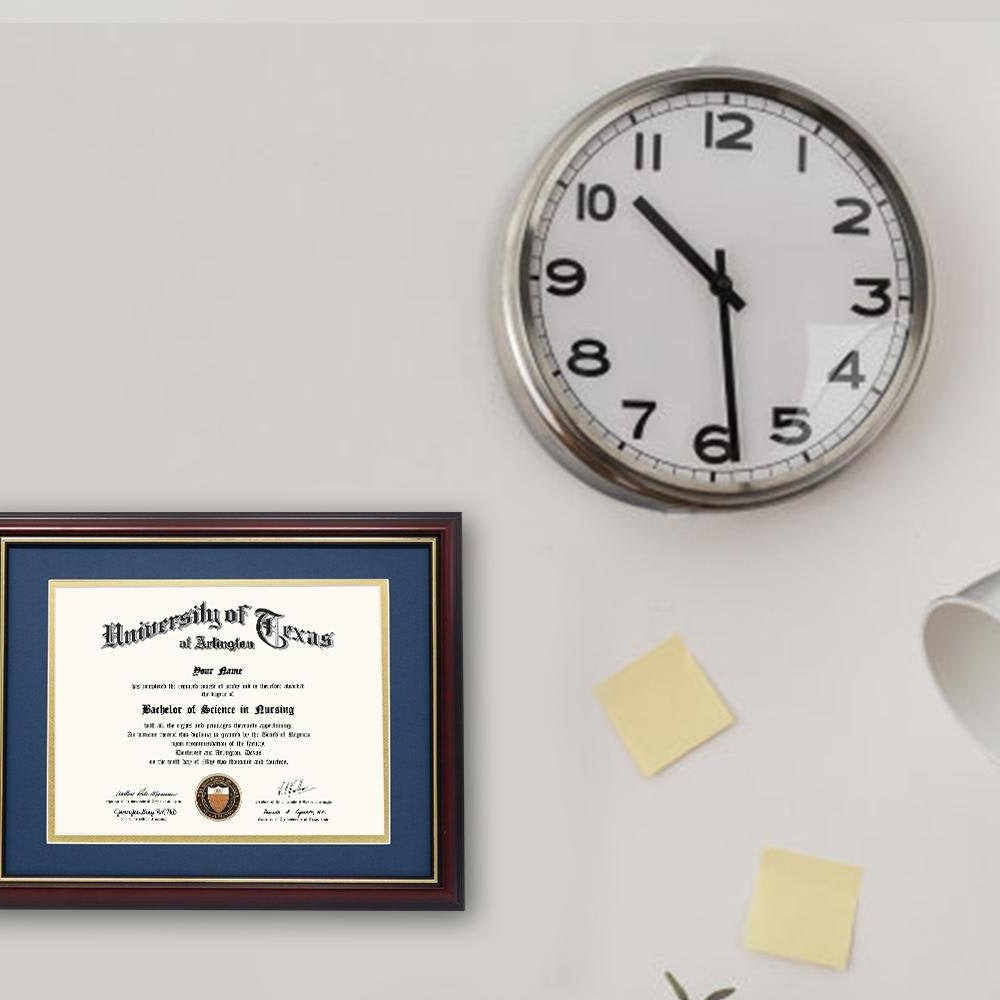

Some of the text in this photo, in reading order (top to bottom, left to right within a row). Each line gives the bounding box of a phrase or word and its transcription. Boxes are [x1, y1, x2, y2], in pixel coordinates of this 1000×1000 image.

[705, 111, 753, 150] 12
[636, 133, 661, 171] 11
[799, 136, 806, 173] 1
[577, 183, 616, 222] 10
[833, 198, 871, 236] 2
[546, 258, 587, 297] 9
[851, 278, 892, 318] 3
[567, 339, 611, 378] 8
[829, 351, 866, 389] 4
[622, 400, 657, 440] 7
[770, 407, 812, 446] 5
[693, 424, 738, 465] 6
[101, 601, 335, 650] University of Texas
[194, 636, 256, 652] Arlington
[192, 665, 242, 676] Your Name
[142, 704, 294, 715] Bachelor of Science in Nursing
